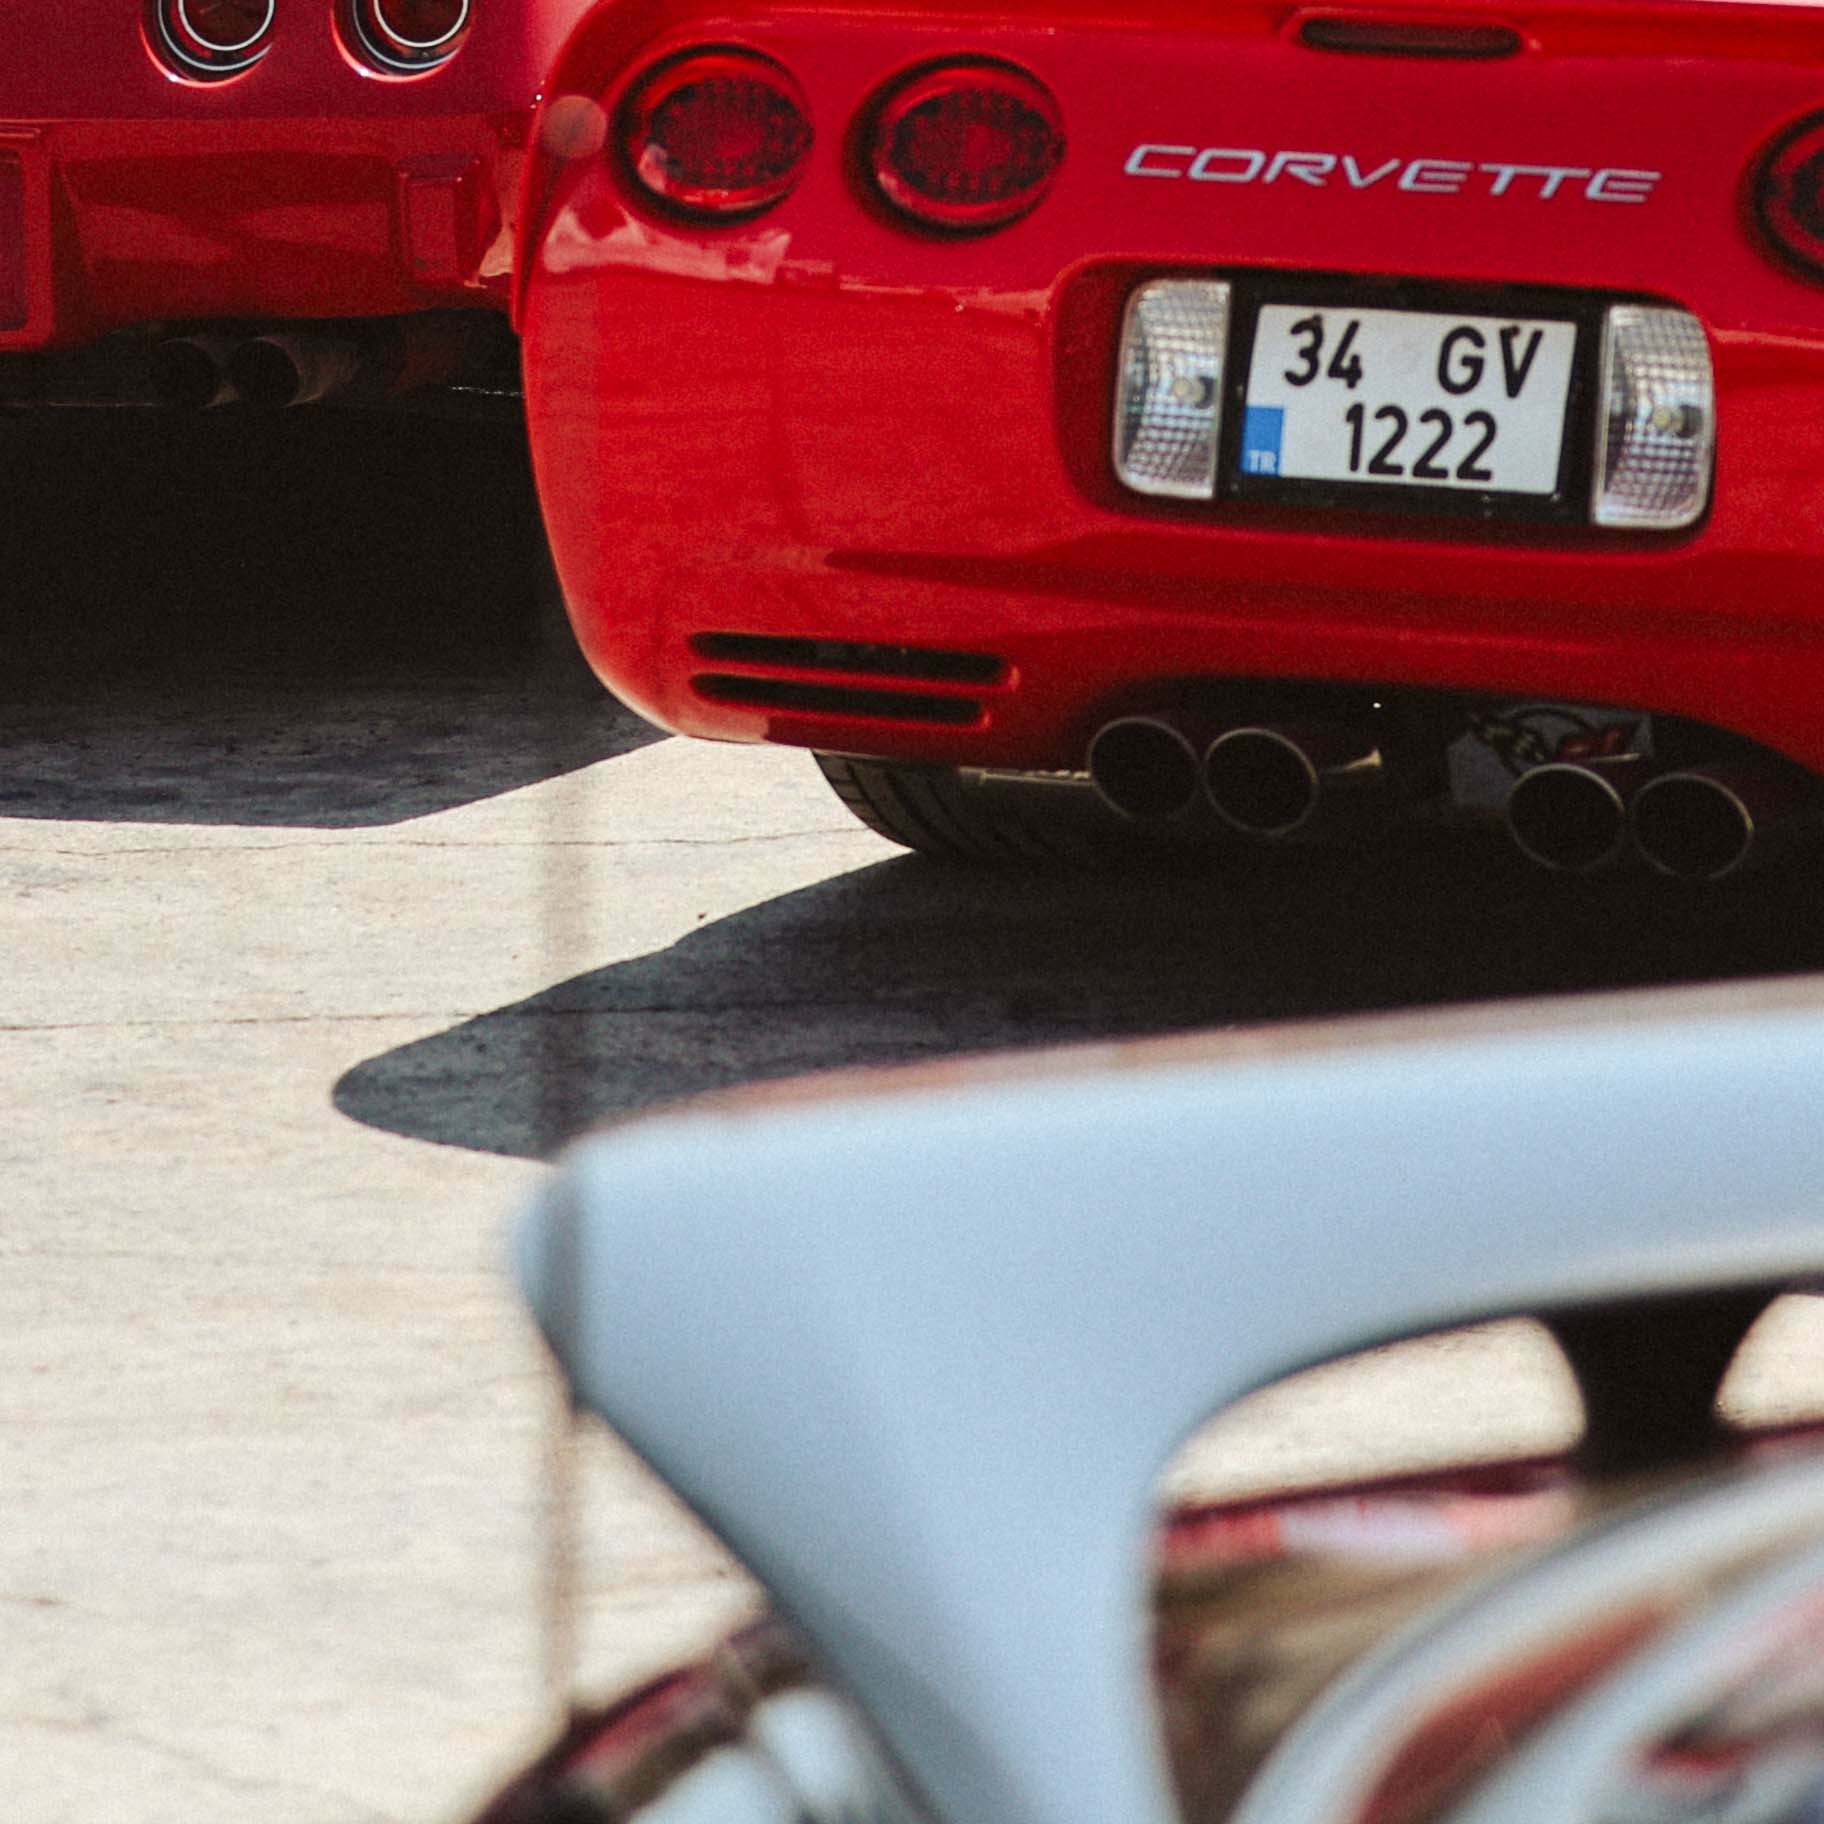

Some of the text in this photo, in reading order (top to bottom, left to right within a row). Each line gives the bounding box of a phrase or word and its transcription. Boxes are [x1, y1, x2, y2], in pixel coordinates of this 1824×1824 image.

[1123, 143, 1662, 203] CORVETTE
[1284, 314, 1544, 399] 34 GV
[1247, 402, 1497, 482] TR 1222
